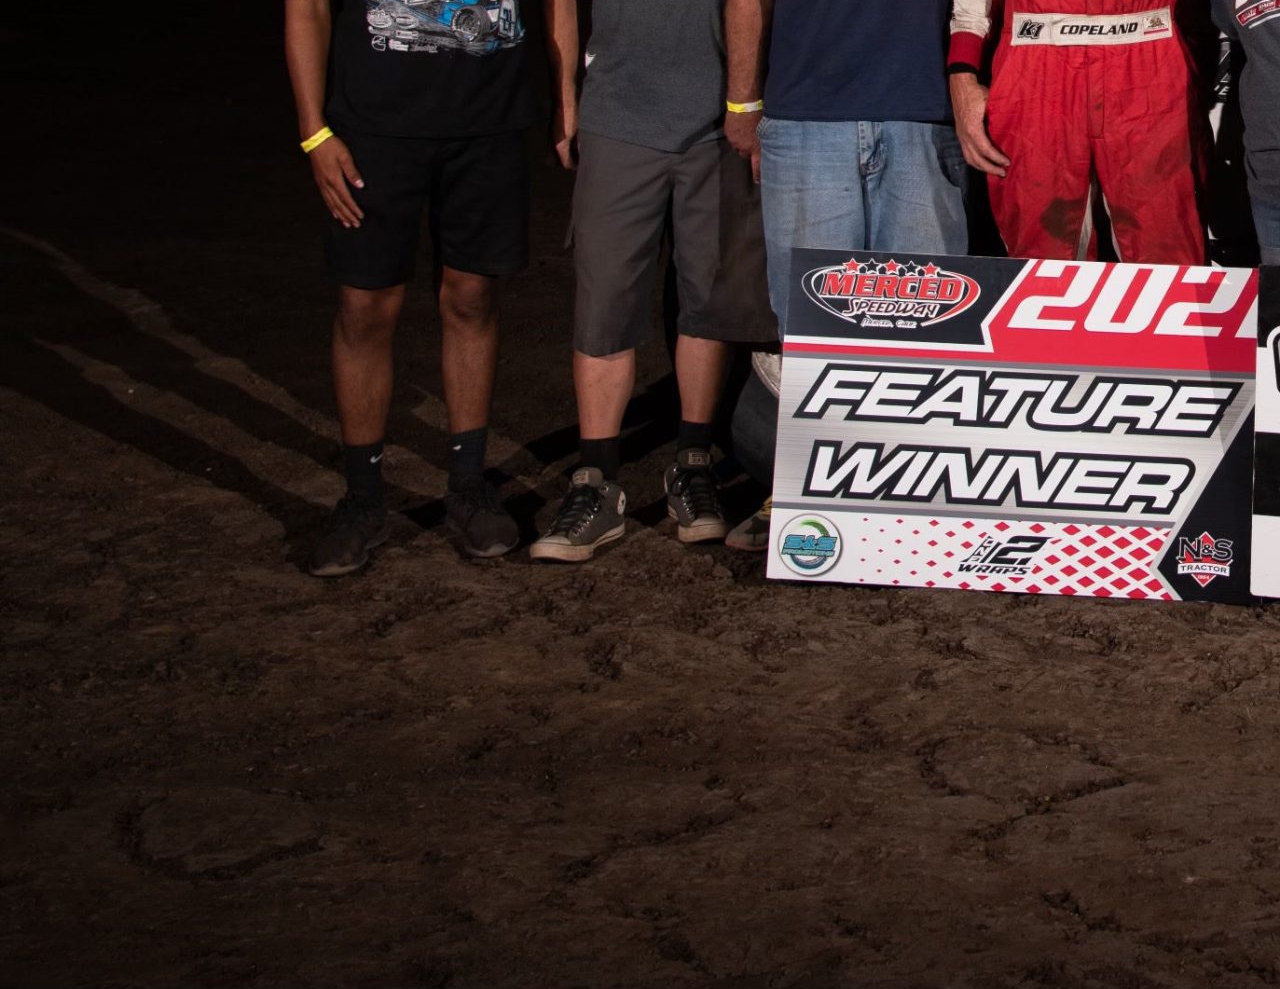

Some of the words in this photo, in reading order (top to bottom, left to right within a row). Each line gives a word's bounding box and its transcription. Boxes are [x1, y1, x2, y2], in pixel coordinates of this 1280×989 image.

[1017, 20, 1045, 39] K1
[1060, 22, 1138, 35] COPELAND
[819, 271, 964, 303] MERCED
[792, 363, 1244, 438] FEATURE
[802, 440, 1195, 515] WINNER
[782, 534, 837, 552] S&S
[1178, 536, 1234, 561] N&S
[958, 564, 1030, 575] WRAPS
[1180, 564, 1227, 573] TRACTOR
